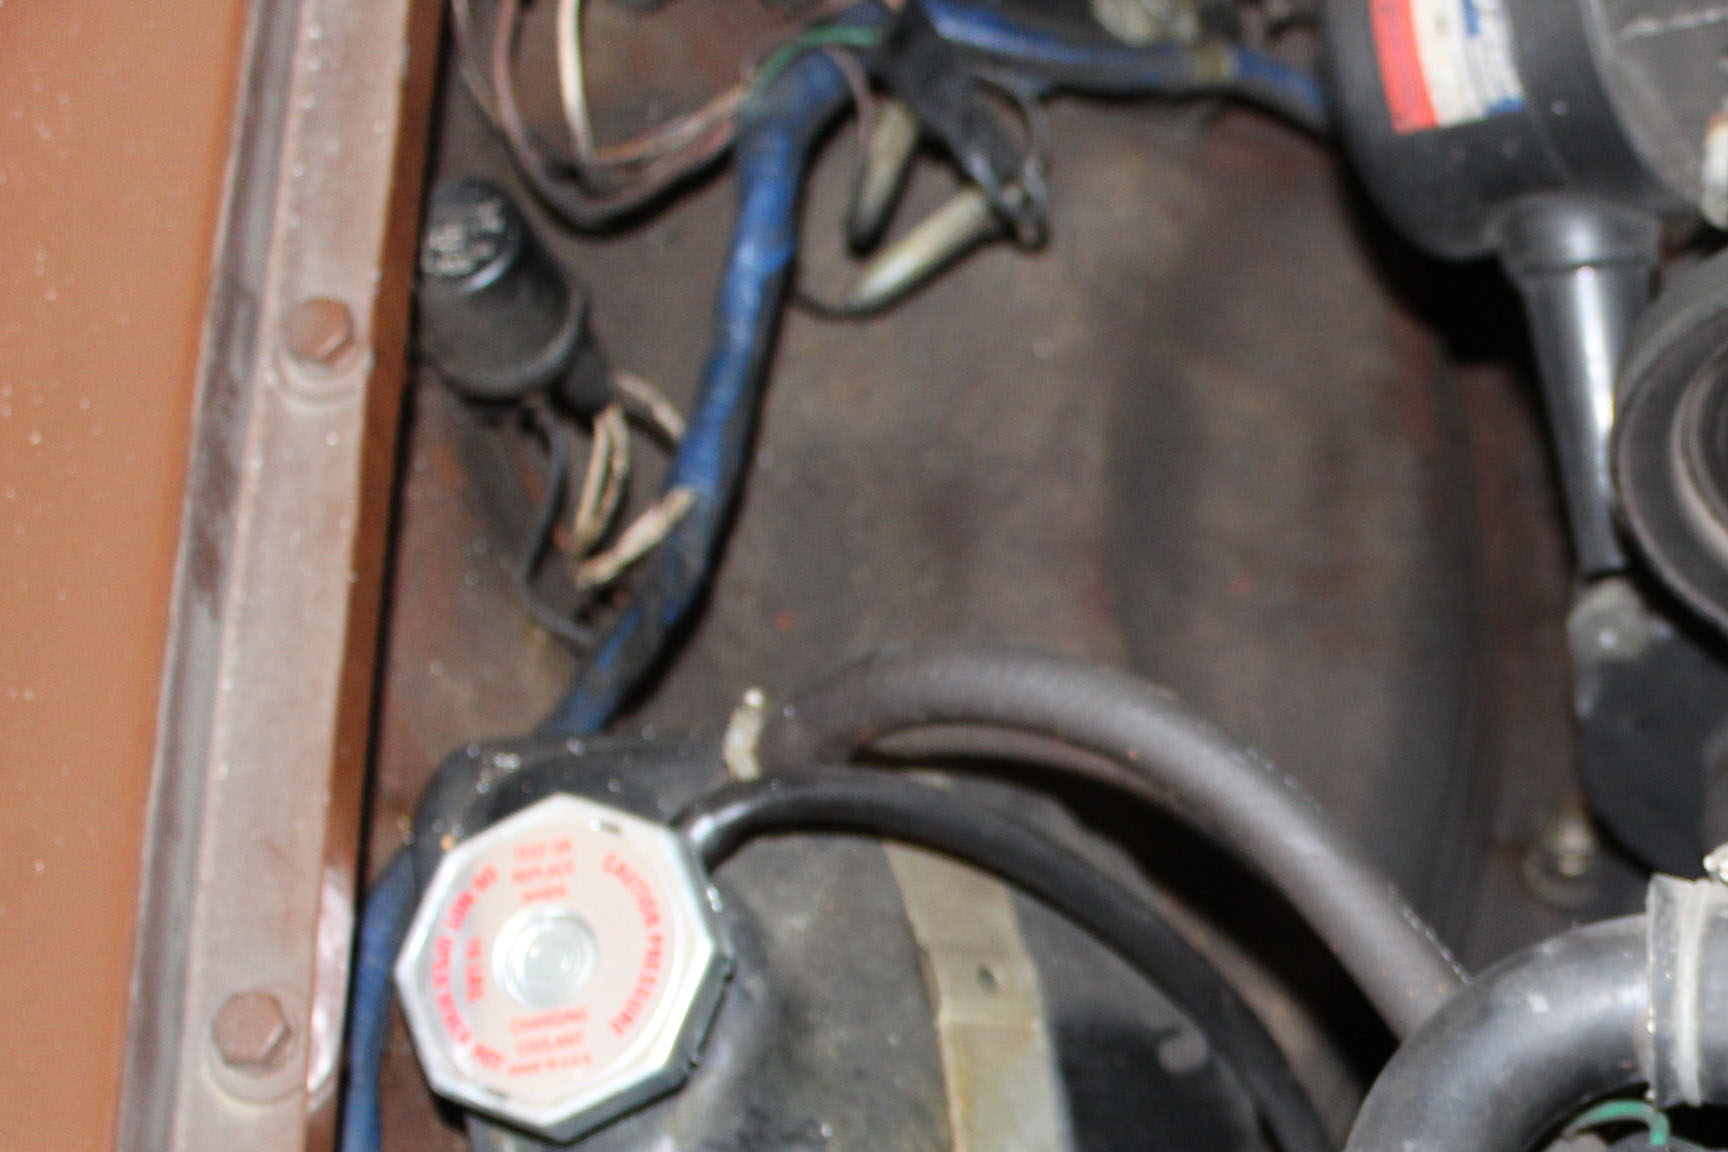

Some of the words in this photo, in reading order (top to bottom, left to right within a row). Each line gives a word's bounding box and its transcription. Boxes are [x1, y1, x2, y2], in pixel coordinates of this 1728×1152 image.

[602, 852, 662, 929] CAUTION
[609, 933, 665, 1036] PRESSURE
[515, 1030, 584, 1056] COOLANT
